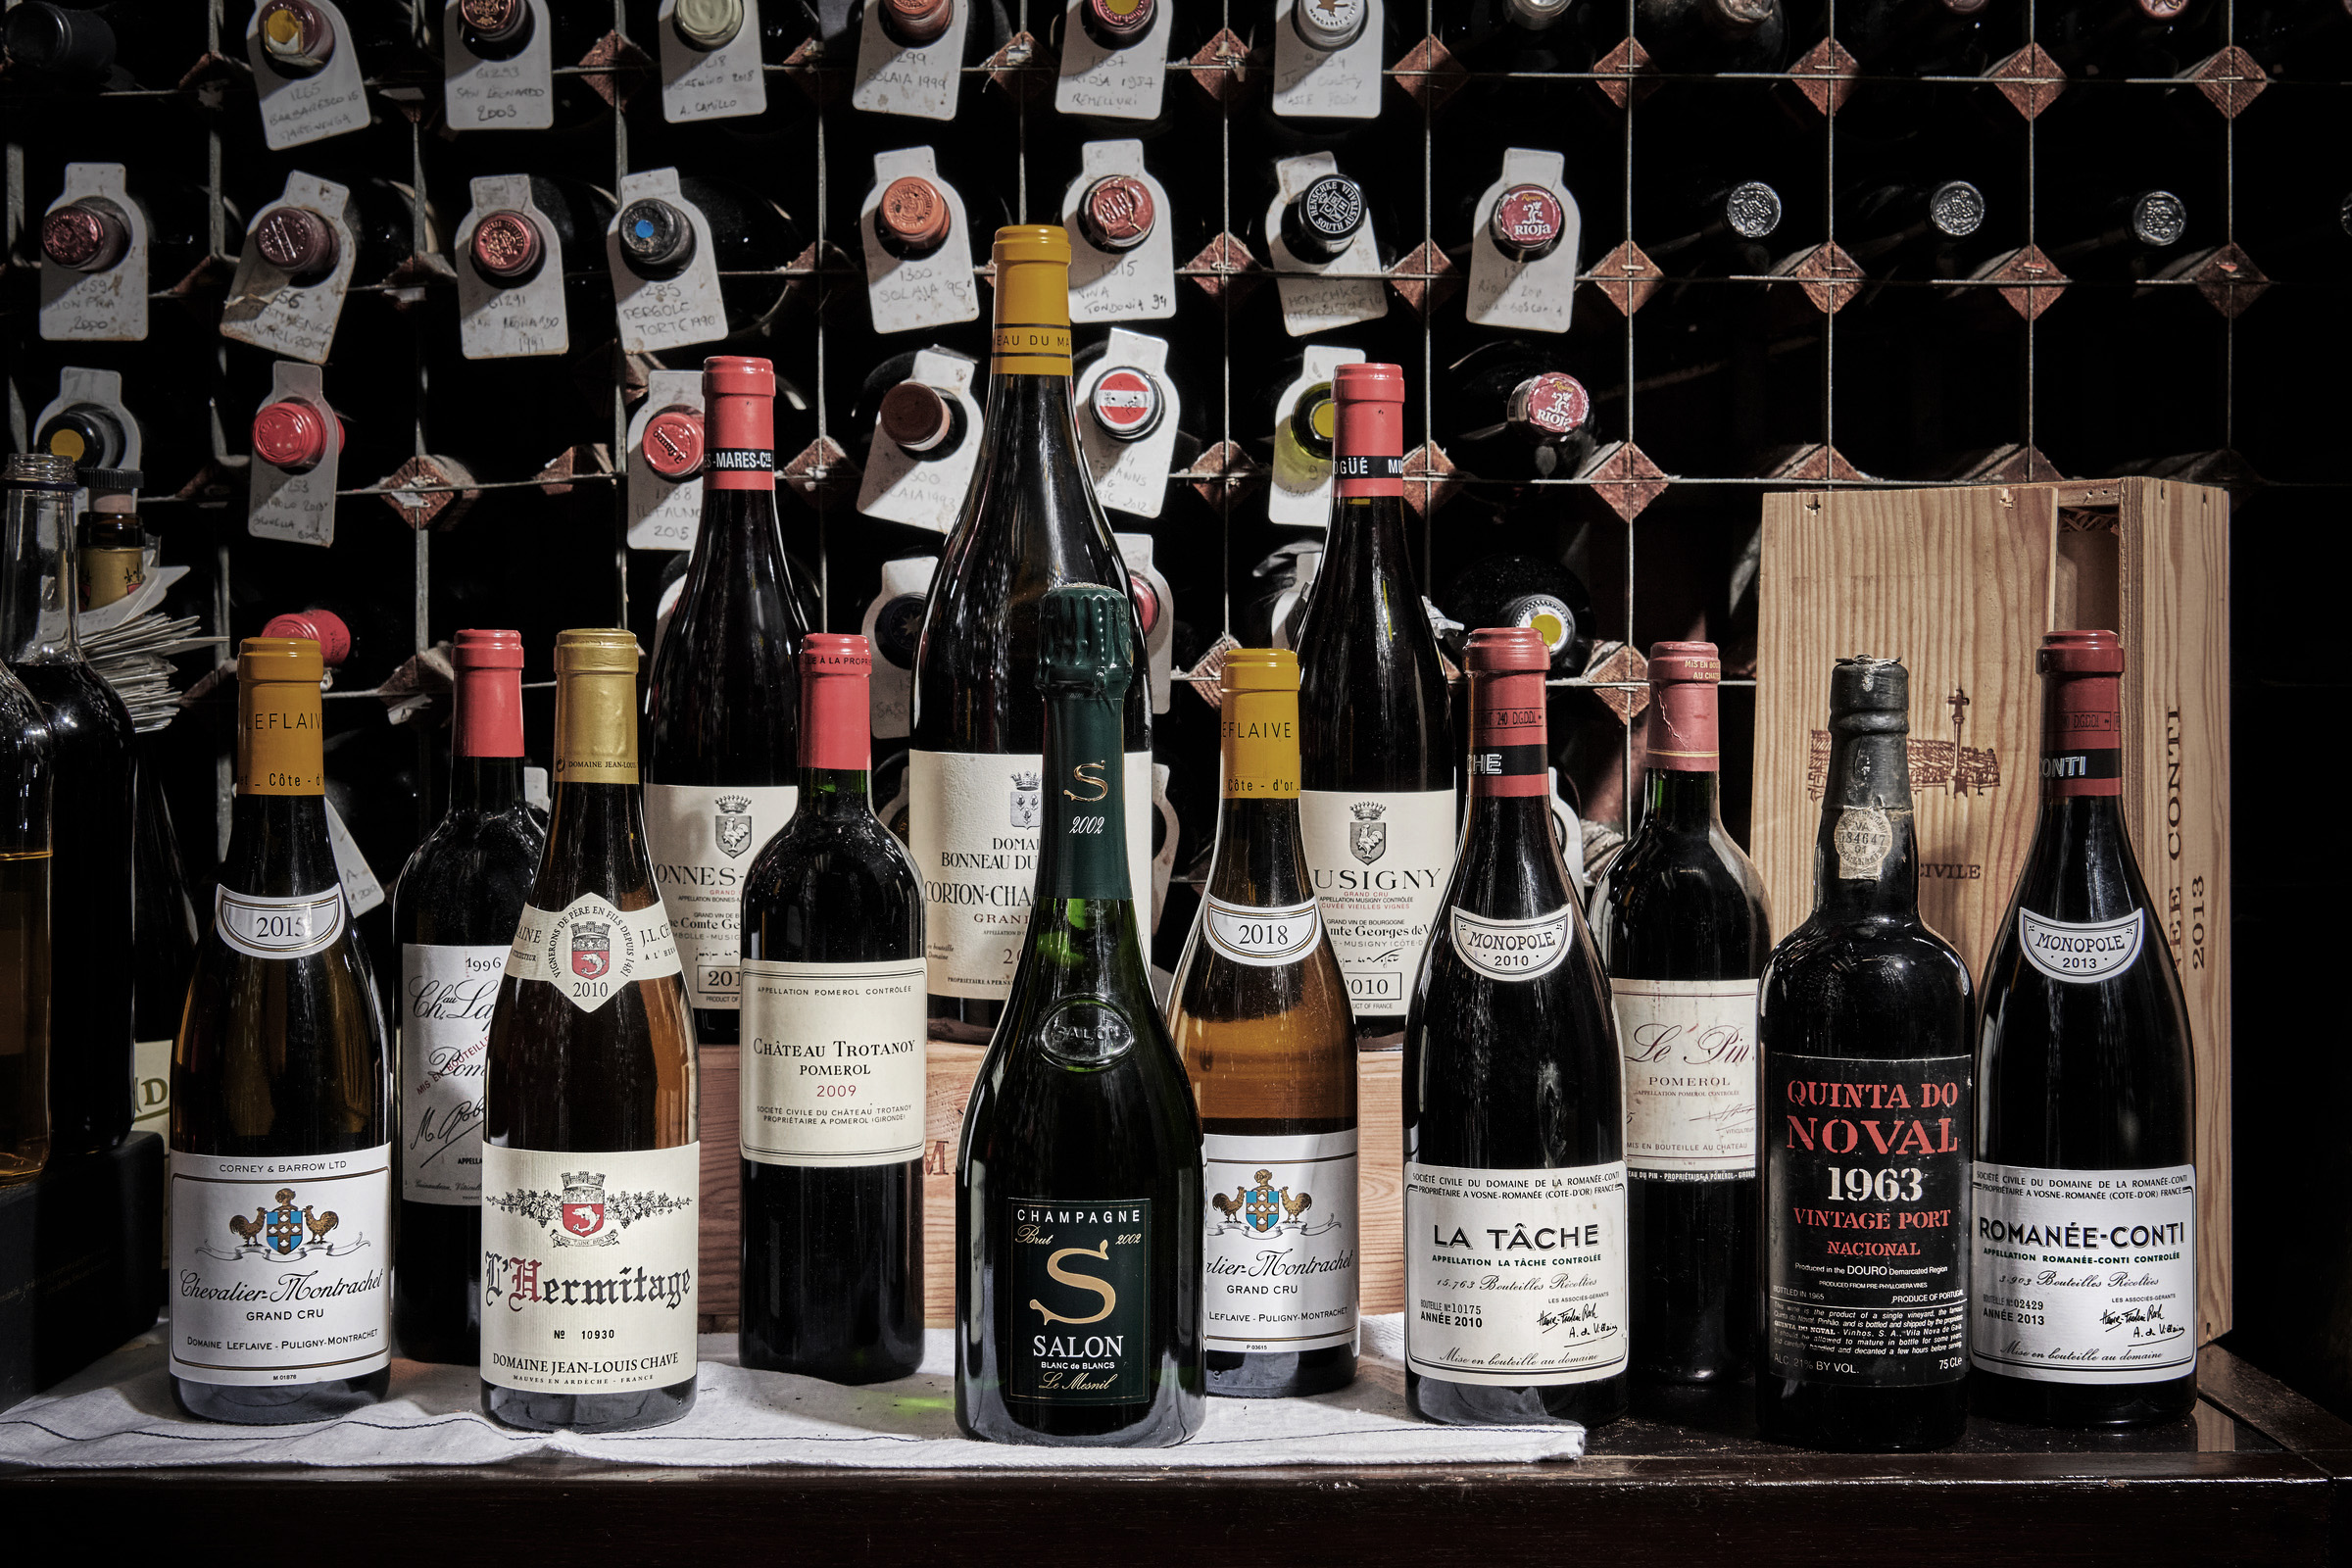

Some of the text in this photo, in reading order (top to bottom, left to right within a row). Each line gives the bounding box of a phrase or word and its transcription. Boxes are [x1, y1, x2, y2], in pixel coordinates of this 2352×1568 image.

[867, 69, 948, 91] SOLAIA 1999
[1121, 76, 1157, 90] 1987
[1310, 182, 1338, 217] HENSCHKE
[1315, 218, 1344, 231] SOUTH
[1029, 335, 1050, 347] DU
[269, 772, 302, 787] Côte
[1227, 779, 1253, 792] Côte
[2167, 706, 2182, 861] CONTI
[1068, 816, 1105, 834] 2002
[941, 852, 1038, 870] BONNEAU DU
[592, 906, 606, 915] EN
[680, 916, 719, 931] Comte
[2191, 874, 2205, 970] 2013
[1238, 924, 1289, 946] 2018
[1355, 926, 1409, 939] Georges
[1467, 932, 1556, 950] MONOPOLE
[2034, 932, 2126, 954] MONOPOLE
[466, 956, 502, 972] 1996
[1494, 956, 1529, 966] 2010
[2062, 956, 2097, 969] 2013
[572, 981, 609, 999] 2010
[757, 985, 912, 997] APPELLATION POMEROL CONTRÔLÉE
[753, 1037, 916, 1057] CHÂTEAU TROTANOY
[1624, 1022, 1750, 1065] Le Pin
[799, 1063, 871, 1077] POMEROL
[1648, 1076, 1732, 1087] POMEROL
[816, 1085, 858, 1099] 2009
[1787, 1079, 1959, 1108] QUINTA DO
[757, 1104, 783, 1115] SOCIÉTÉ
[831, 1107, 873, 1116] CHÂTEAU
[876, 1103, 912, 1115] TROTANOY
[763, 1114, 869, 1125] PROPRIÉTAIRE POMEROL
[1786, 1114, 1959, 1155] NOVAL
[1654, 1142, 1699, 1152] BOUTEILLE
[1716, 1141, 1748, 1151] CHATEAU
[219, 1160, 348, 1174] CORNEY BARROW LTD
[1412, 1171, 1620, 1188] SOCIÉTÉ CIVILE DU DOMAINE DE LA ROMANÉE-CONTI
[1828, 1166, 1924, 1202] 1963
[1418, 1186, 1461, 1199] PROPRIÉTAIRE
[1471, 1190, 1543, 1200] VOSNE-ROMANÉE
[1593, 1184, 1615, 1194] FRANCE
[1017, 1208, 1141, 1224] CHAMPAGNE
[1793, 1206, 1951, 1230] VINTAGE PORT
[1014, 1224, 1142, 1246] Brut 2002
[1434, 1222, 1599, 1251] LA TÂCHE
[1979, 1216, 2184, 1250] ROMANÉE-CONTI
[1826, 1241, 1922, 1256] NACIONAL
[1983, 1247, 2180, 1264] APPELLATION ROMANÉE-CONTI CONTROLÉE
[1432, 1254, 1492, 1267] APPELLATION
[1514, 1256, 1546, 1267] TÂCHE
[1551, 1253, 1602, 1266] CONTROLÉE
[1794, 1262, 1929, 1276] Produced DOURO Demarcated
[179, 1268, 385, 1303] Chevalier-Montrachet
[484, 1250, 692, 1313] L'Hermitage
[1029, 1239, 1117, 1326] S
[1479, 1272, 1598, 1292] Bouteilles Récoltées
[2036, 1269, 2160, 1289] Bouteilles Récoltées
[1226, 1284, 1299, 1296] GRAND CRU
[245, 1308, 325, 1322] GRAND CRU
[1208, 1306, 1348, 1323] LEFLAIVE PULIGNY-MONTRACHET
[1420, 1310, 1484, 1329] ANNÉE 2010
[1983, 1306, 2046, 1326] ANNÉE 2013
[186, 1328, 379, 1351] DOMAINE LEFLAIVE PULIGNY-MONTRACHET
[581, 1329, 615, 1341] 10930
[1032, 1334, 1125, 1358] SALON
[492, 1351, 680, 1376] DOMAINE JEAN-LOUIS CHAVE
[1041, 1360, 1116, 1370] BLANC de BLANCS
[1815, 1360, 1861, 1375] BY VOL.
[1038, 1371, 1119, 1391] Le Mesnil
